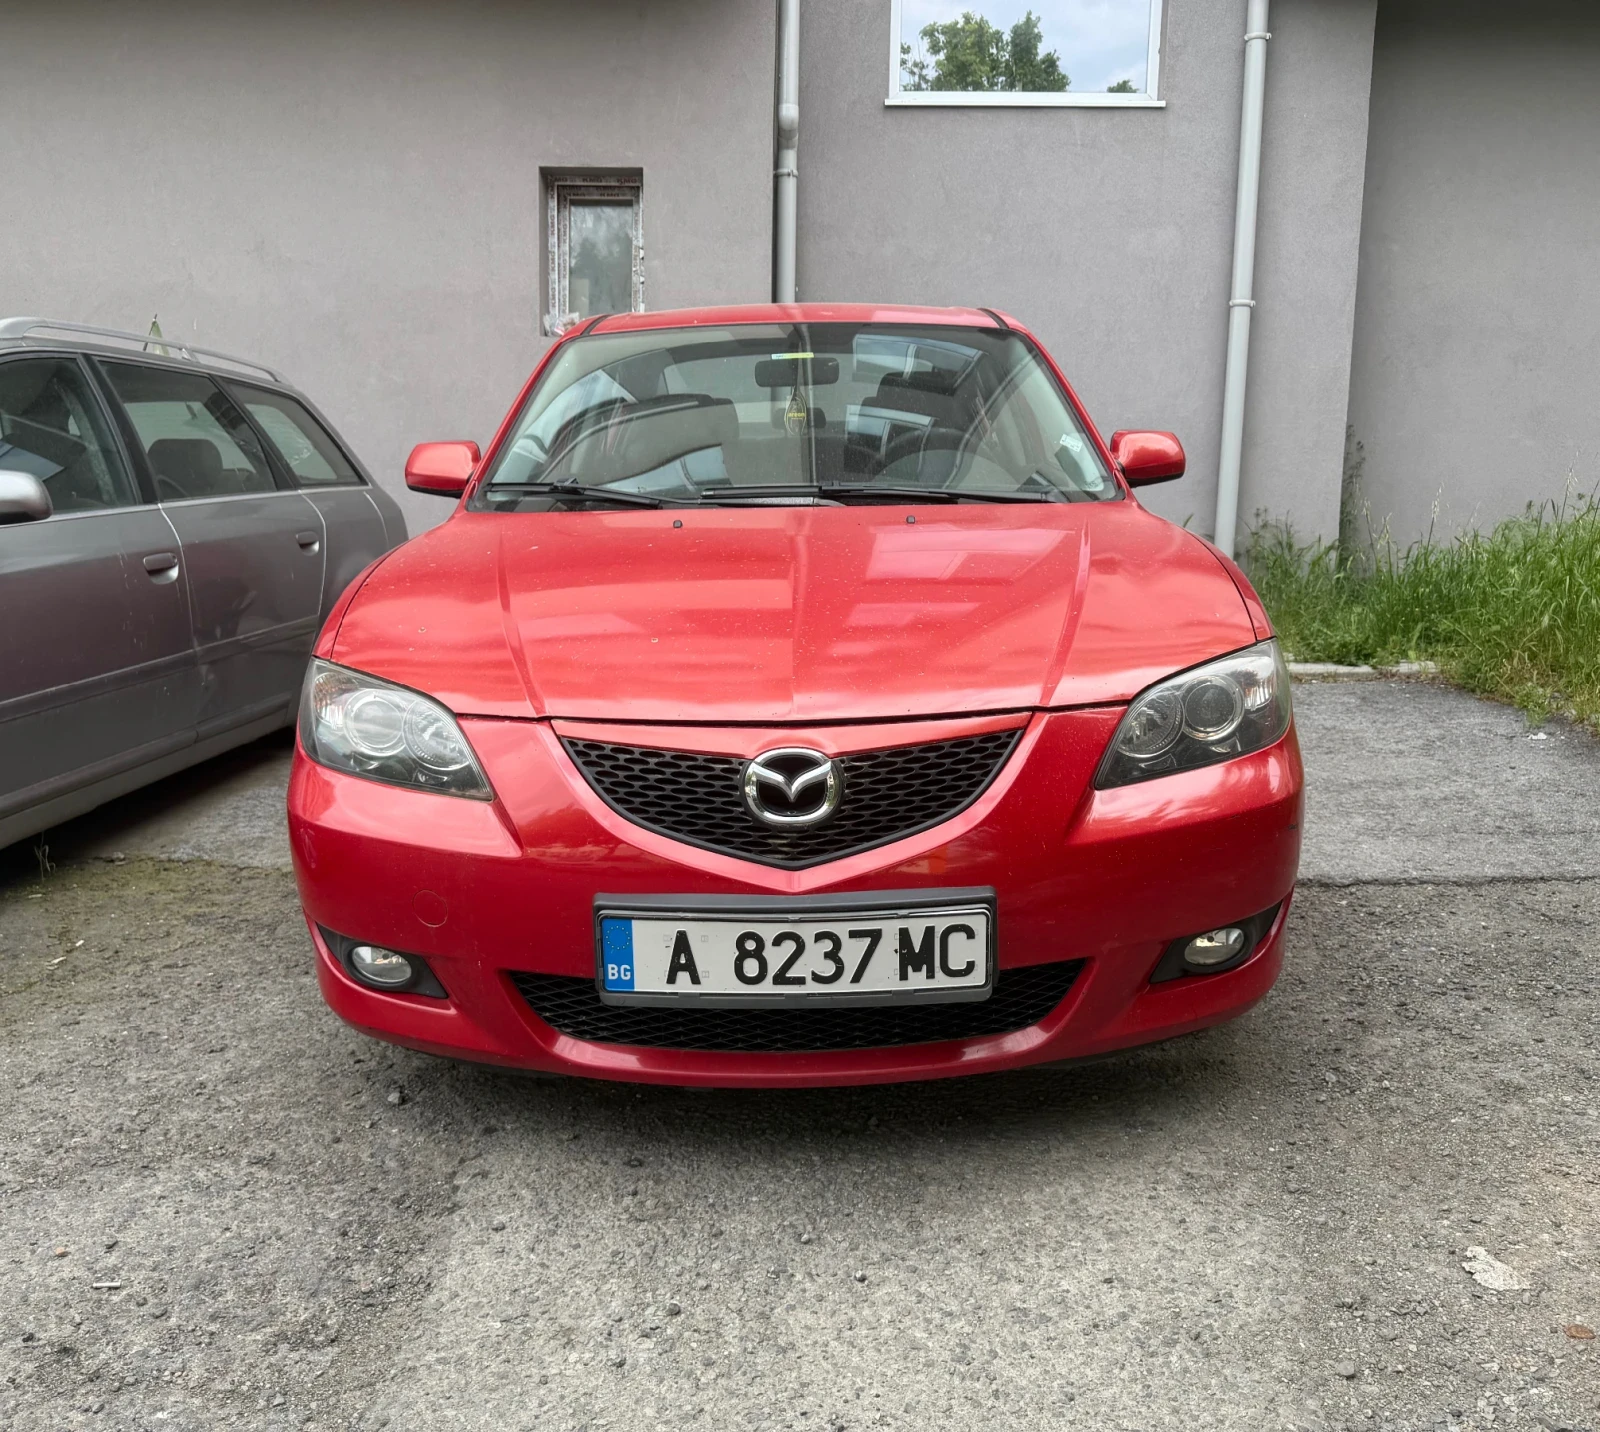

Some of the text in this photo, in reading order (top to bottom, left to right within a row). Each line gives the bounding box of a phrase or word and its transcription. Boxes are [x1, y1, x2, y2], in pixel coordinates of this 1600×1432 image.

[607, 963, 631, 980] BG
[666, 923, 976, 986] A 8237 MC
